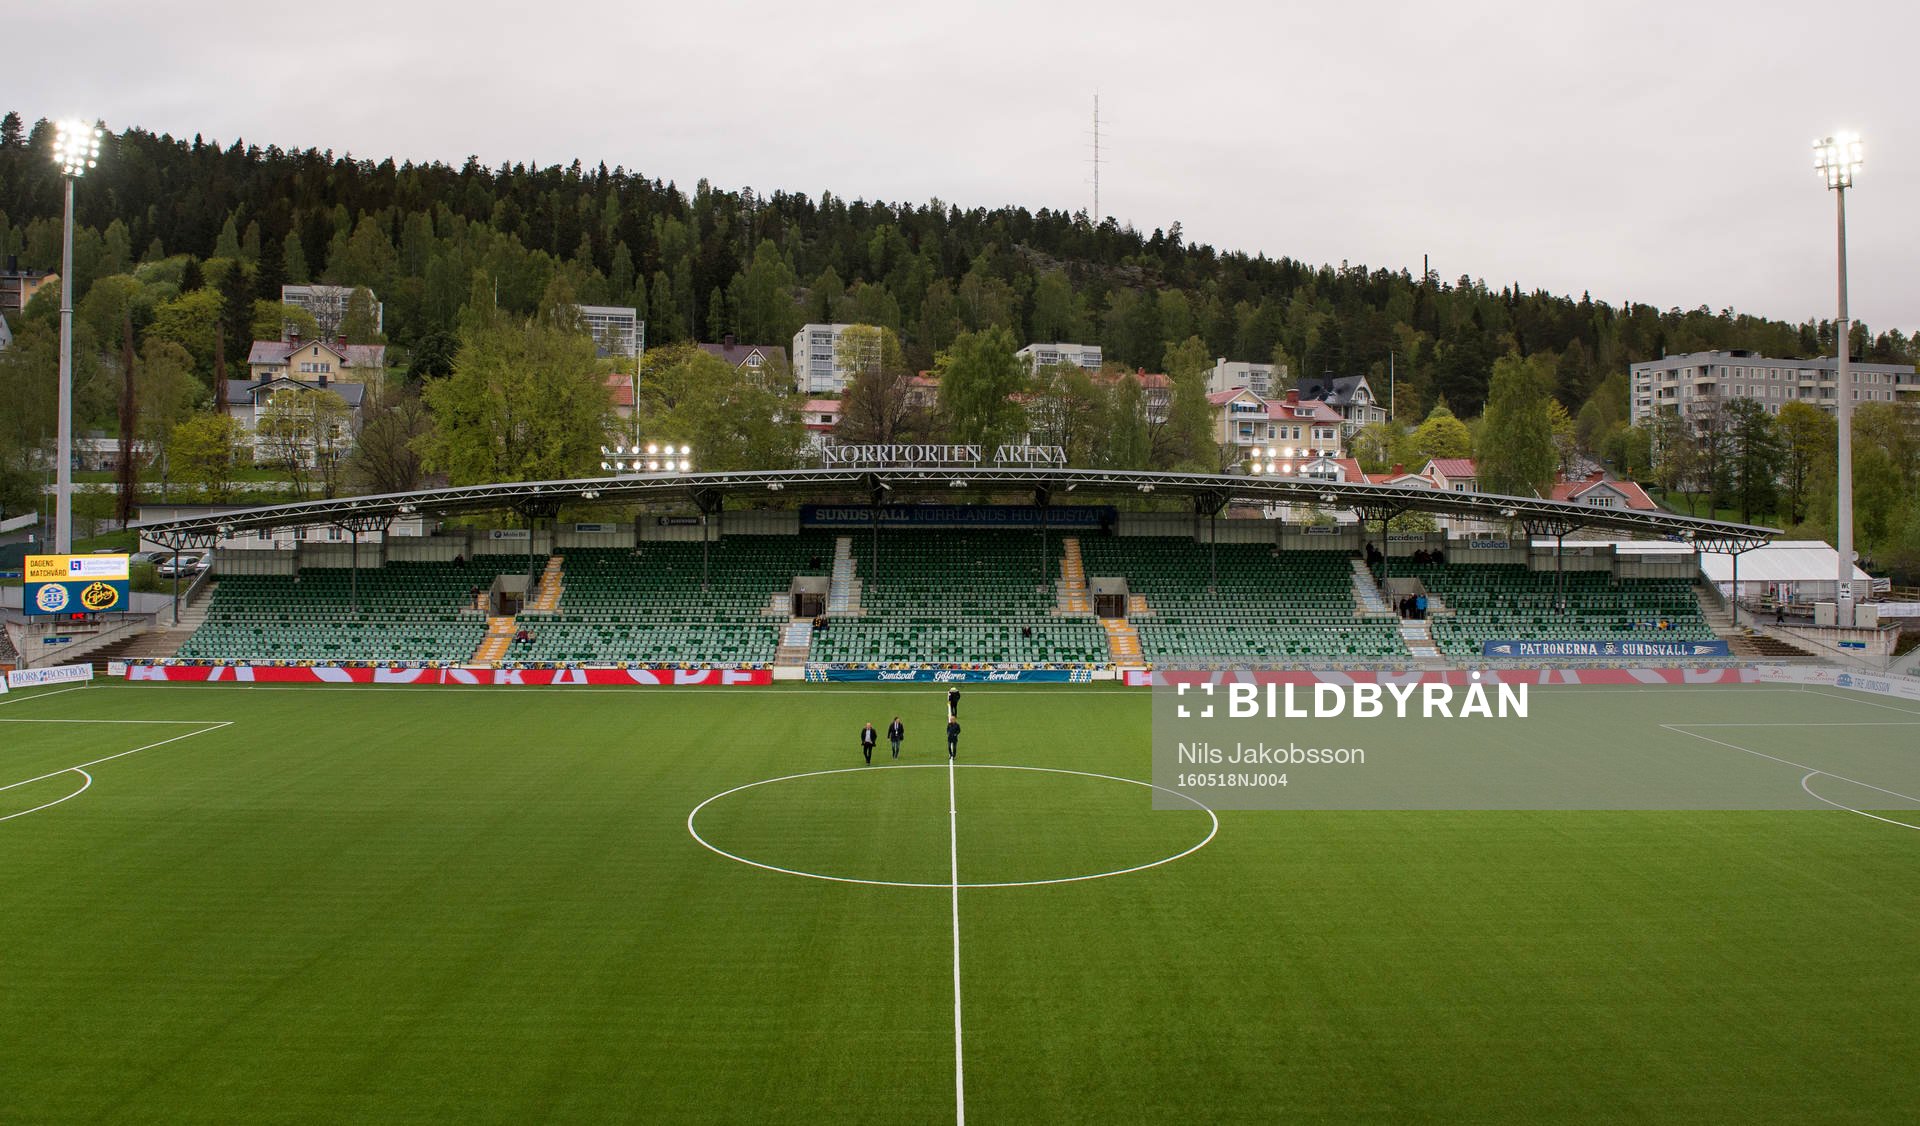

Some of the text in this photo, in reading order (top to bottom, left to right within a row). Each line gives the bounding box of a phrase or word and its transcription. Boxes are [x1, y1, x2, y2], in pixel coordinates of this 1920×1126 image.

[822, 445, 1067, 463] NORRPORTEN ARENA
[815, 509, 909, 521] SUNDSVALL
[913, 509, 1006, 522] NORRLANDS
[1840, 582, 1850, 590] WC
[1520, 643, 1688, 655] PATRONERNA SUNDSVALL
[12, 671, 41, 684] BJÖRK
[877, 670, 1020, 682] Sundsvall Giffarna Norrland
[1854, 677, 1865, 689] TRE
